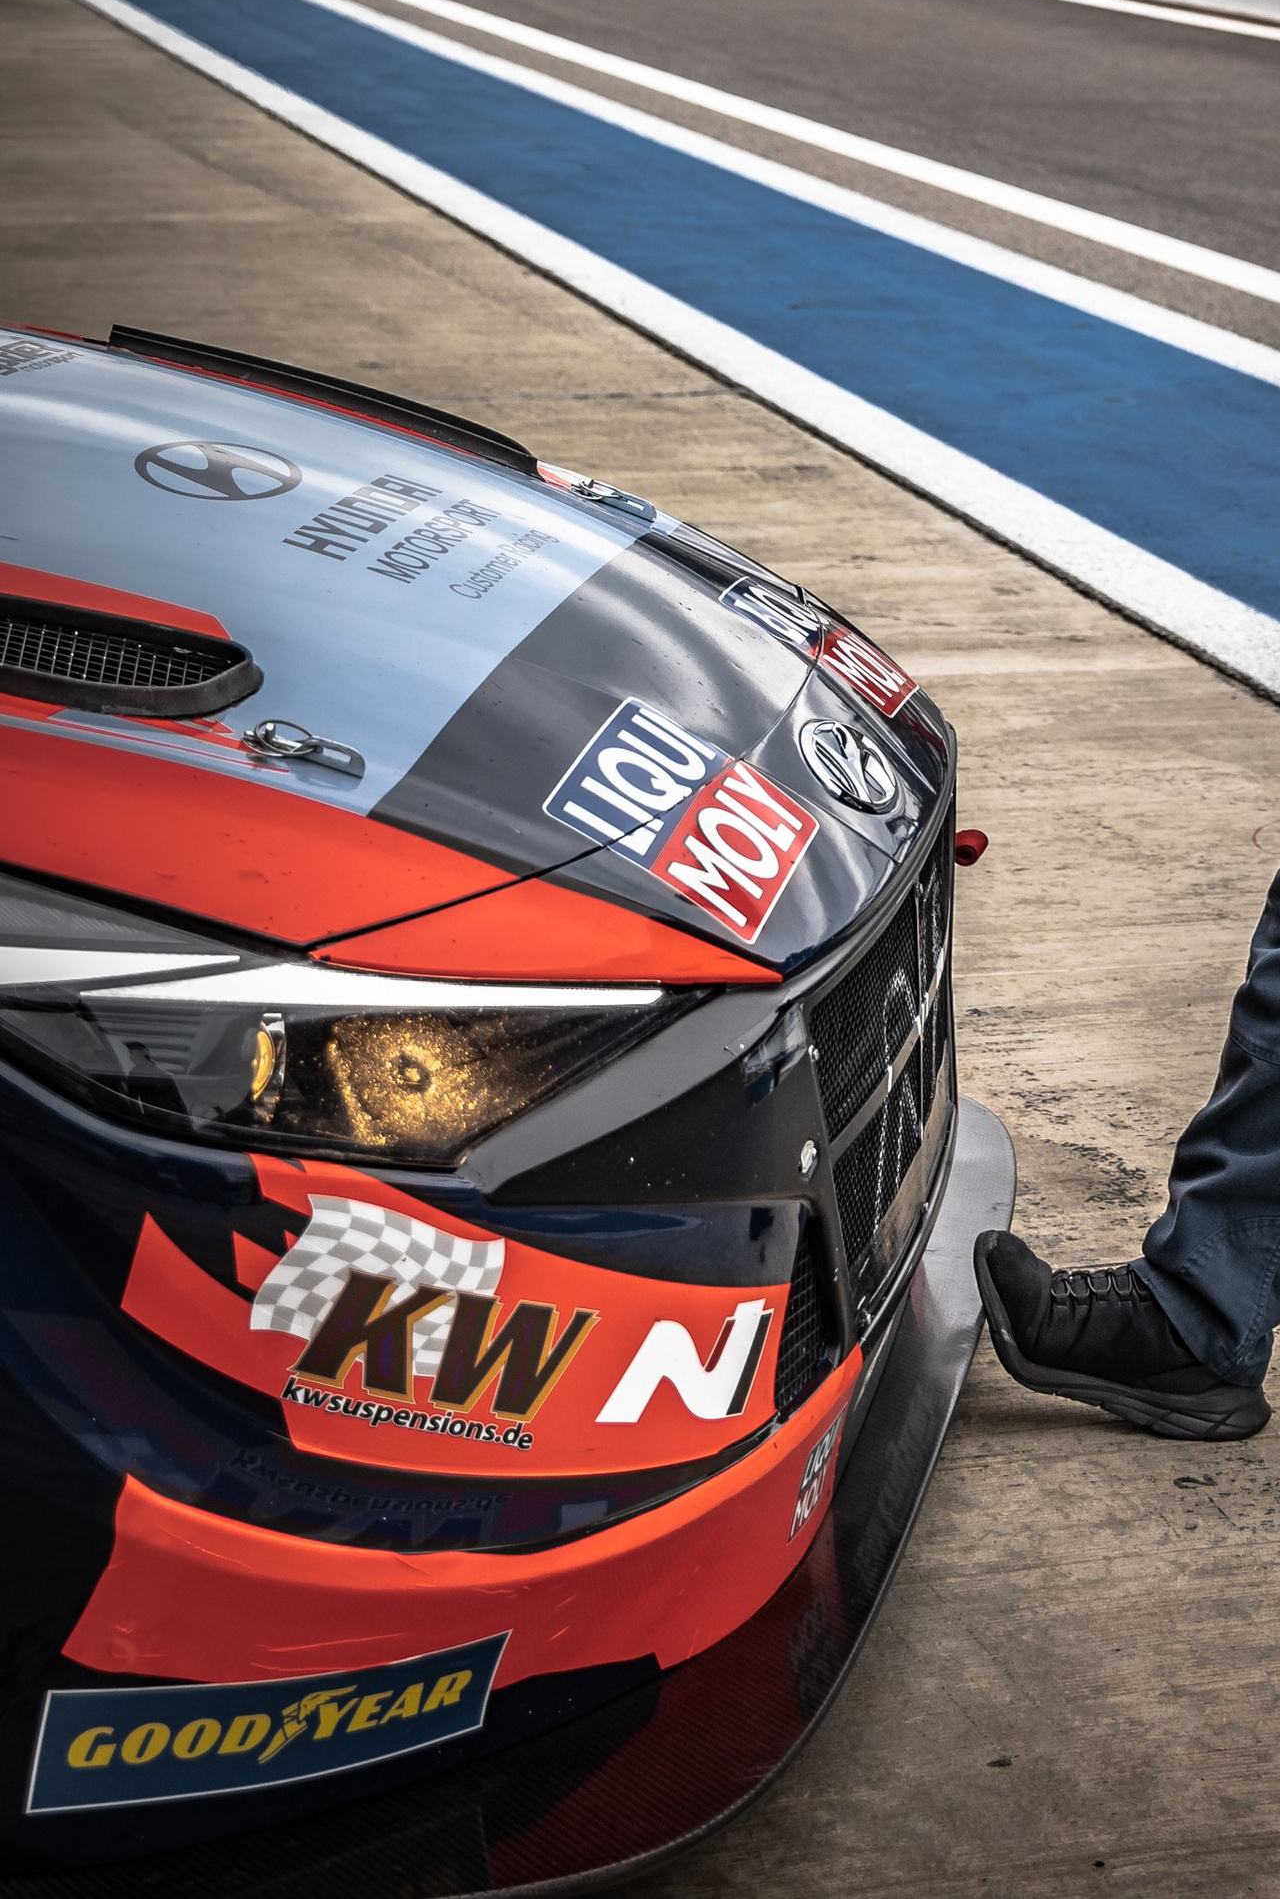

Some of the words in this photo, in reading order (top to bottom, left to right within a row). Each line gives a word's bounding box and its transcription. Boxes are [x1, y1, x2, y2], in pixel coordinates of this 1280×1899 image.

[282, 474, 444, 561] HYUNDAI
[367, 498, 502, 584] MOTORSPORT
[449, 551, 522, 599] Customer
[498, 529, 560, 559] Racing
[563, 707, 717, 856] LIQUI
[666, 762, 803, 928] MOLY
[287, 1268, 601, 1423] KW
[281, 1377, 535, 1450] kwsuspensions.de
[67, 1670, 474, 1768] GOODYEAR
